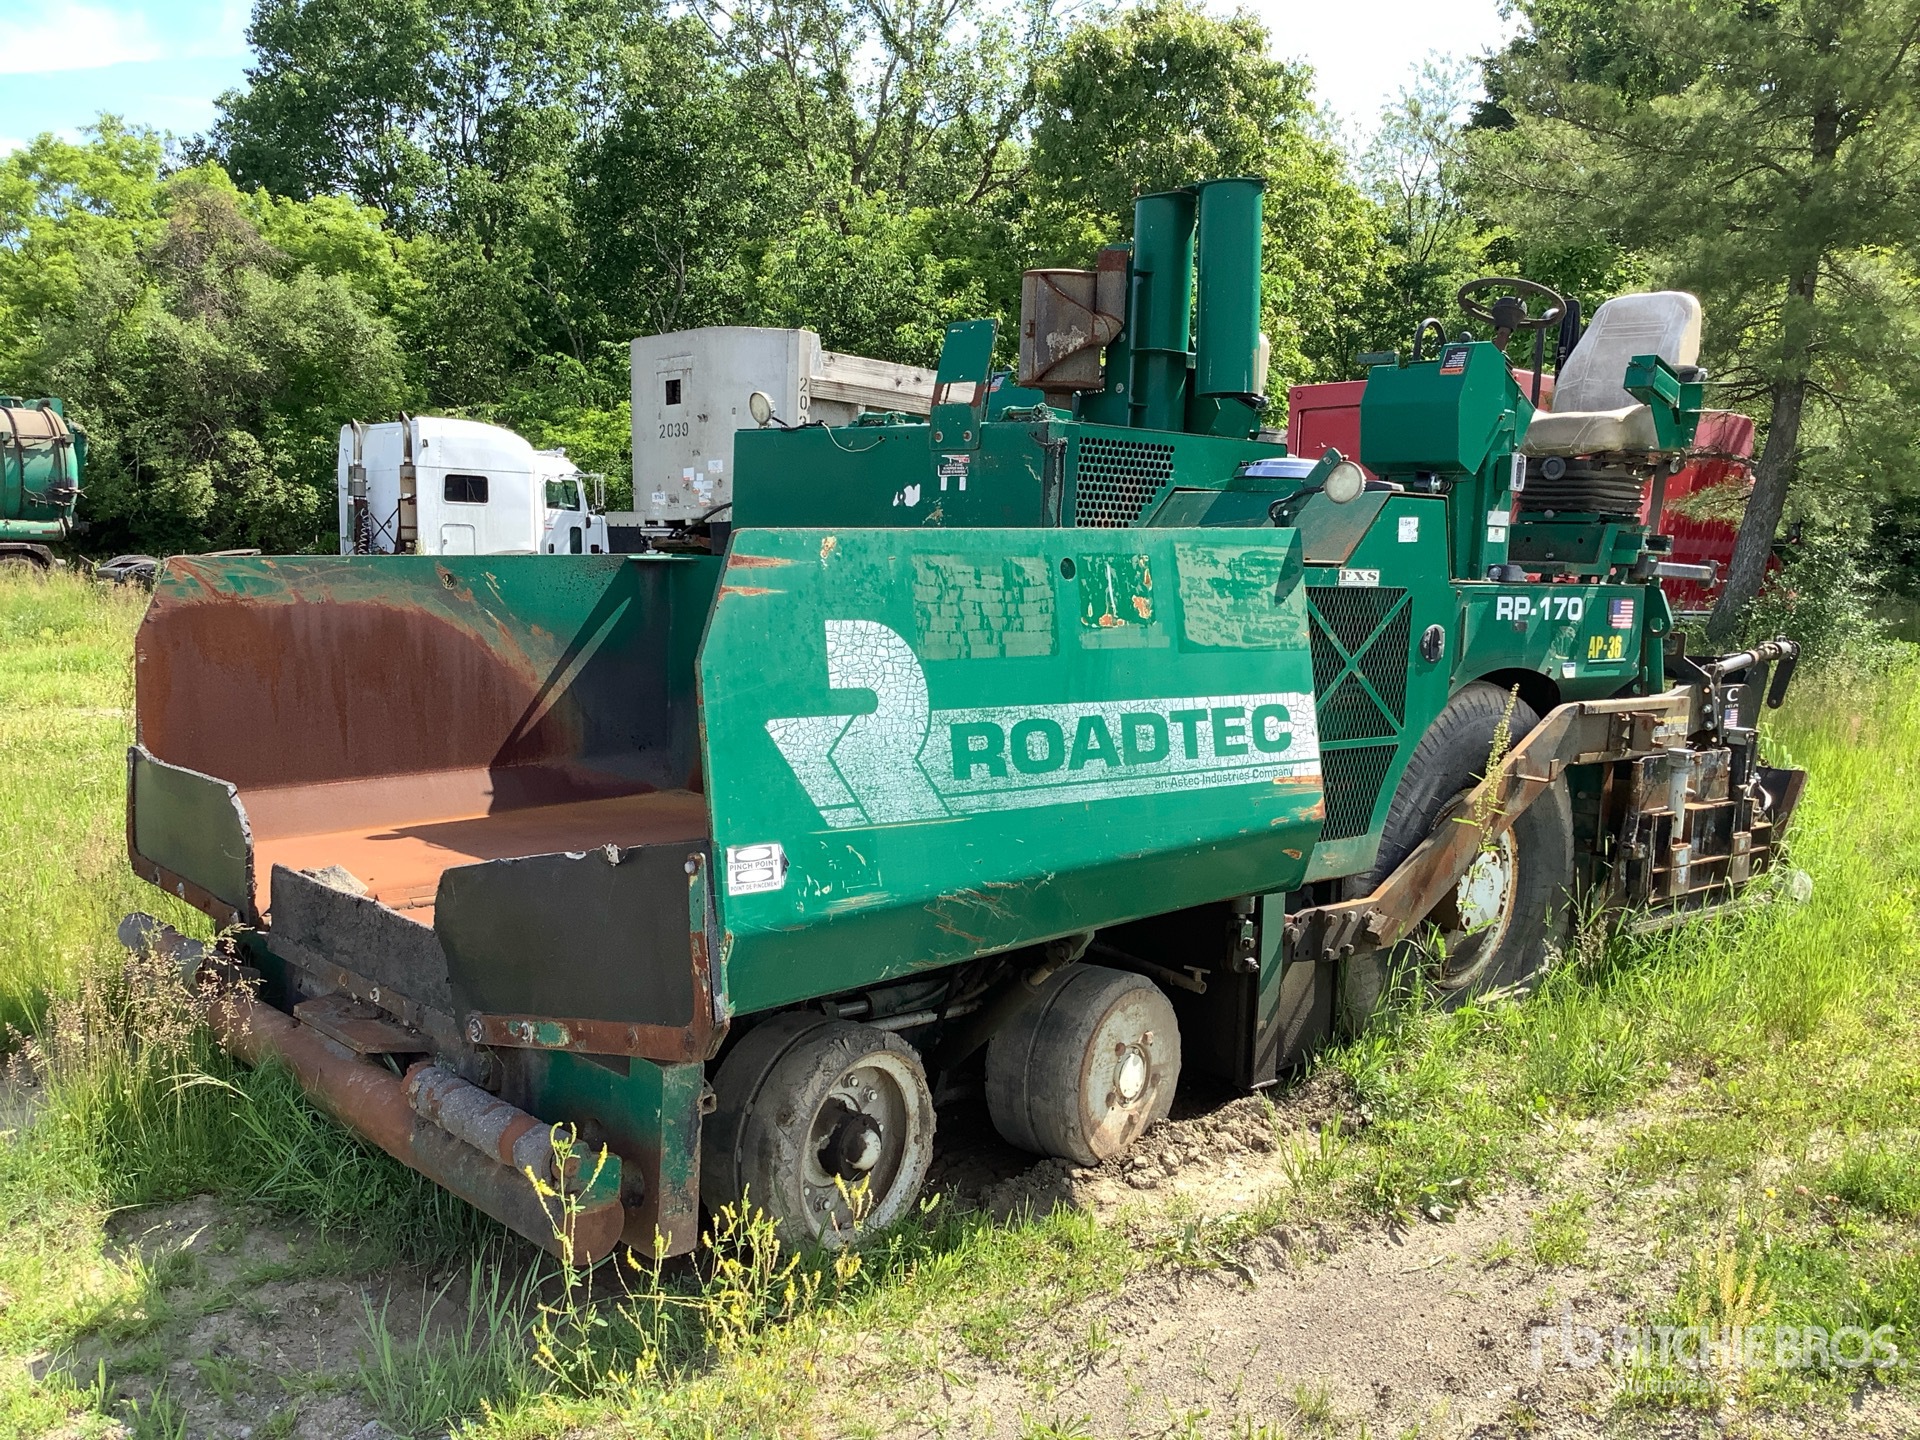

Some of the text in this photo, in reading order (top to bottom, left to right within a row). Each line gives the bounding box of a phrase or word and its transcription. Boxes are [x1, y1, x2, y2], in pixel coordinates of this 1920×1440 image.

[659, 422, 689, 439] 2039
[1496, 596, 1583, 621] RP-170
[1587, 635, 1622, 659] AP-36
[950, 703, 1293, 780] ROADTEC
[1155, 767, 1294, 790] an Astec Industries Company
[729, 859, 778, 872] PINCH POINT
[753, 881, 780, 889] PINCEMENT
